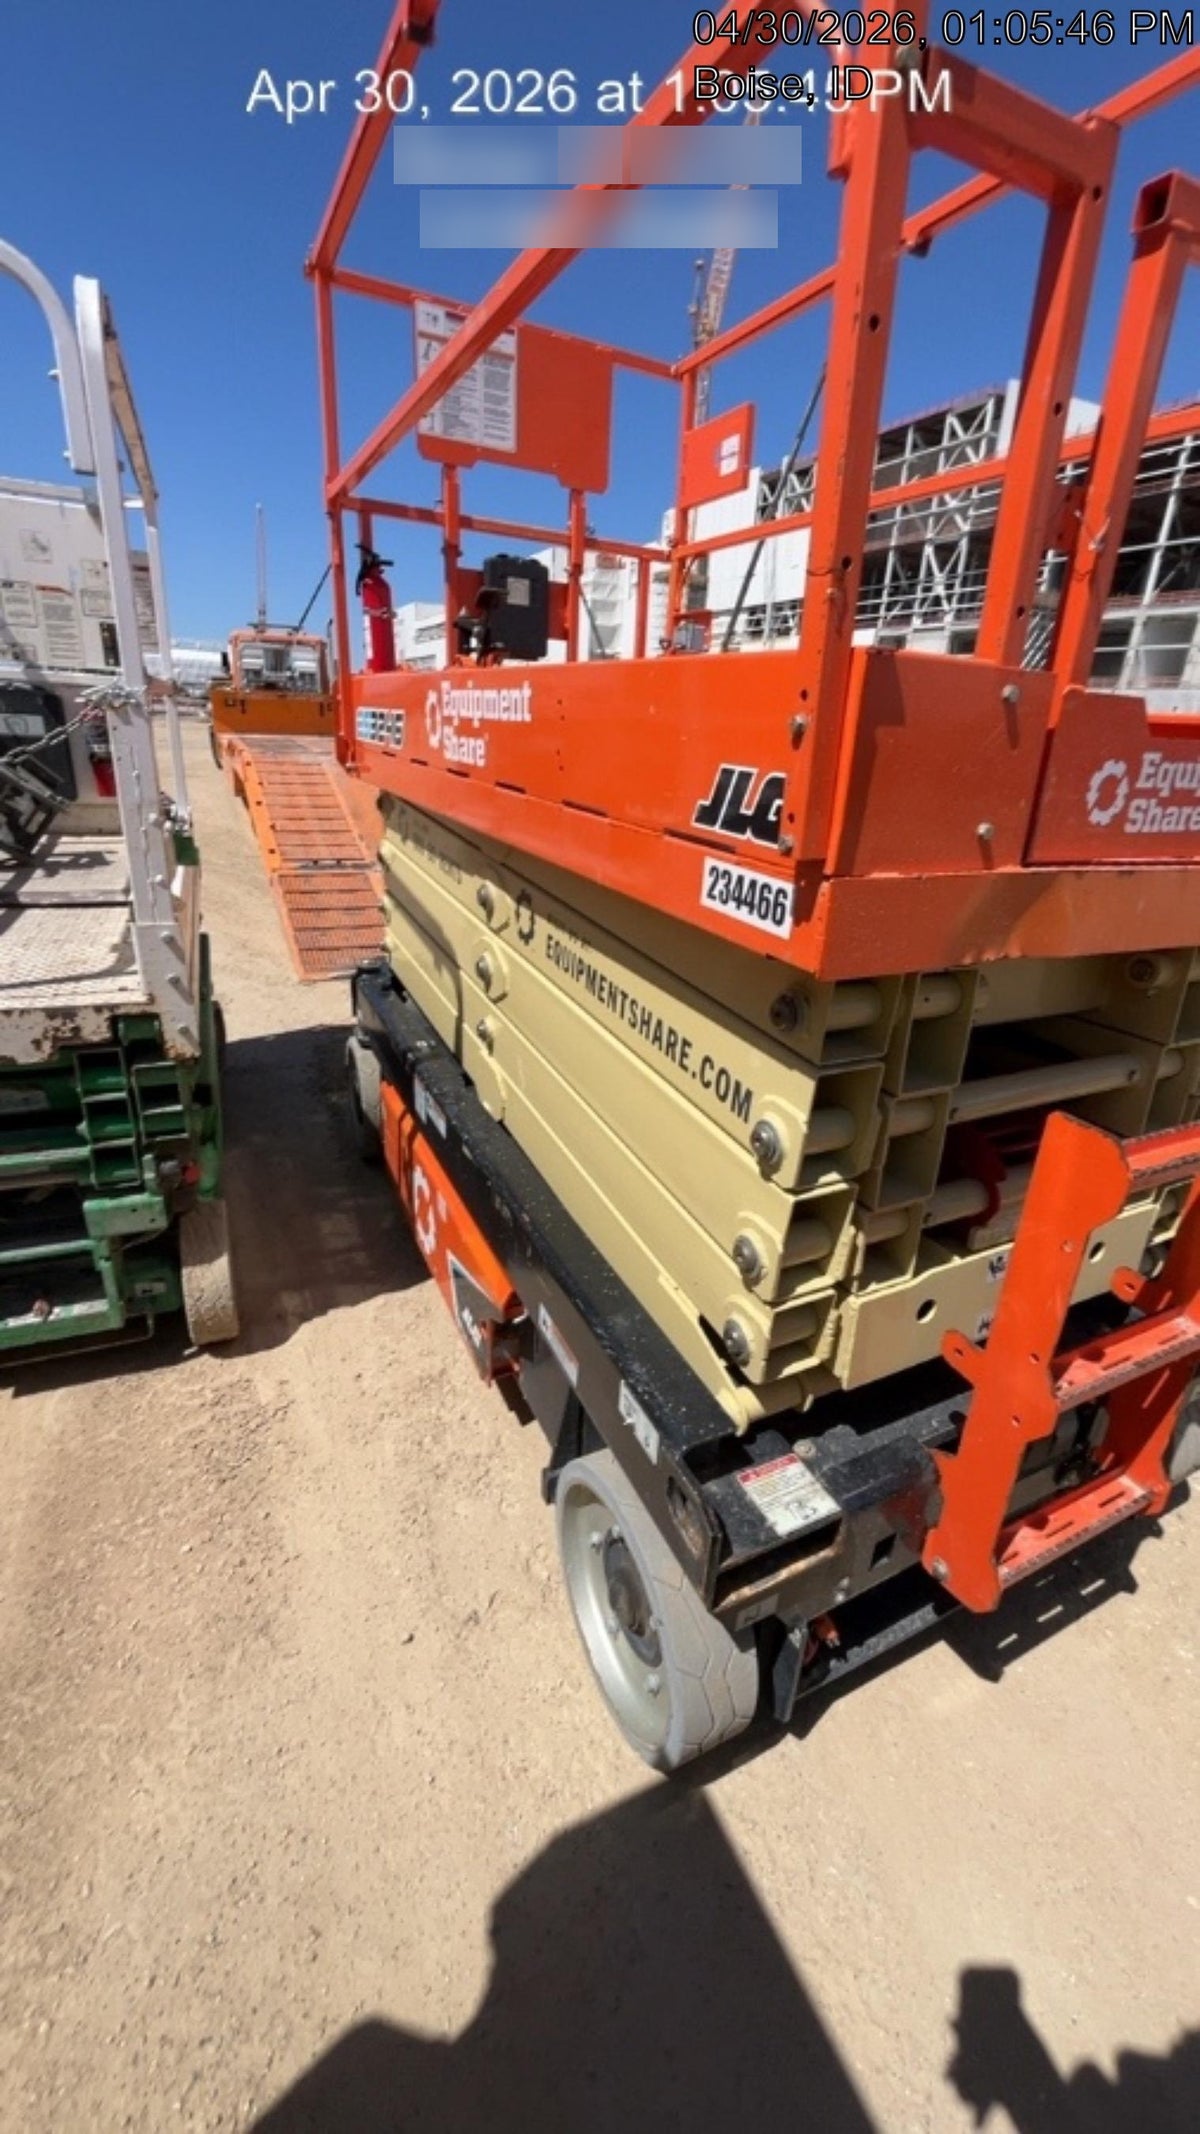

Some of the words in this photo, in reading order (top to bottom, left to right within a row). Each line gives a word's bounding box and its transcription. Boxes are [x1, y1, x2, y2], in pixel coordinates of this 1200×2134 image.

[441, 680, 532, 728] Equipment
[442, 725, 485, 767] Share
[1123, 797, 1200, 834] Share
[706, 865, 789, 927] 234466
[545, 933, 754, 1124] EQUIPMENTSHARE.COM
